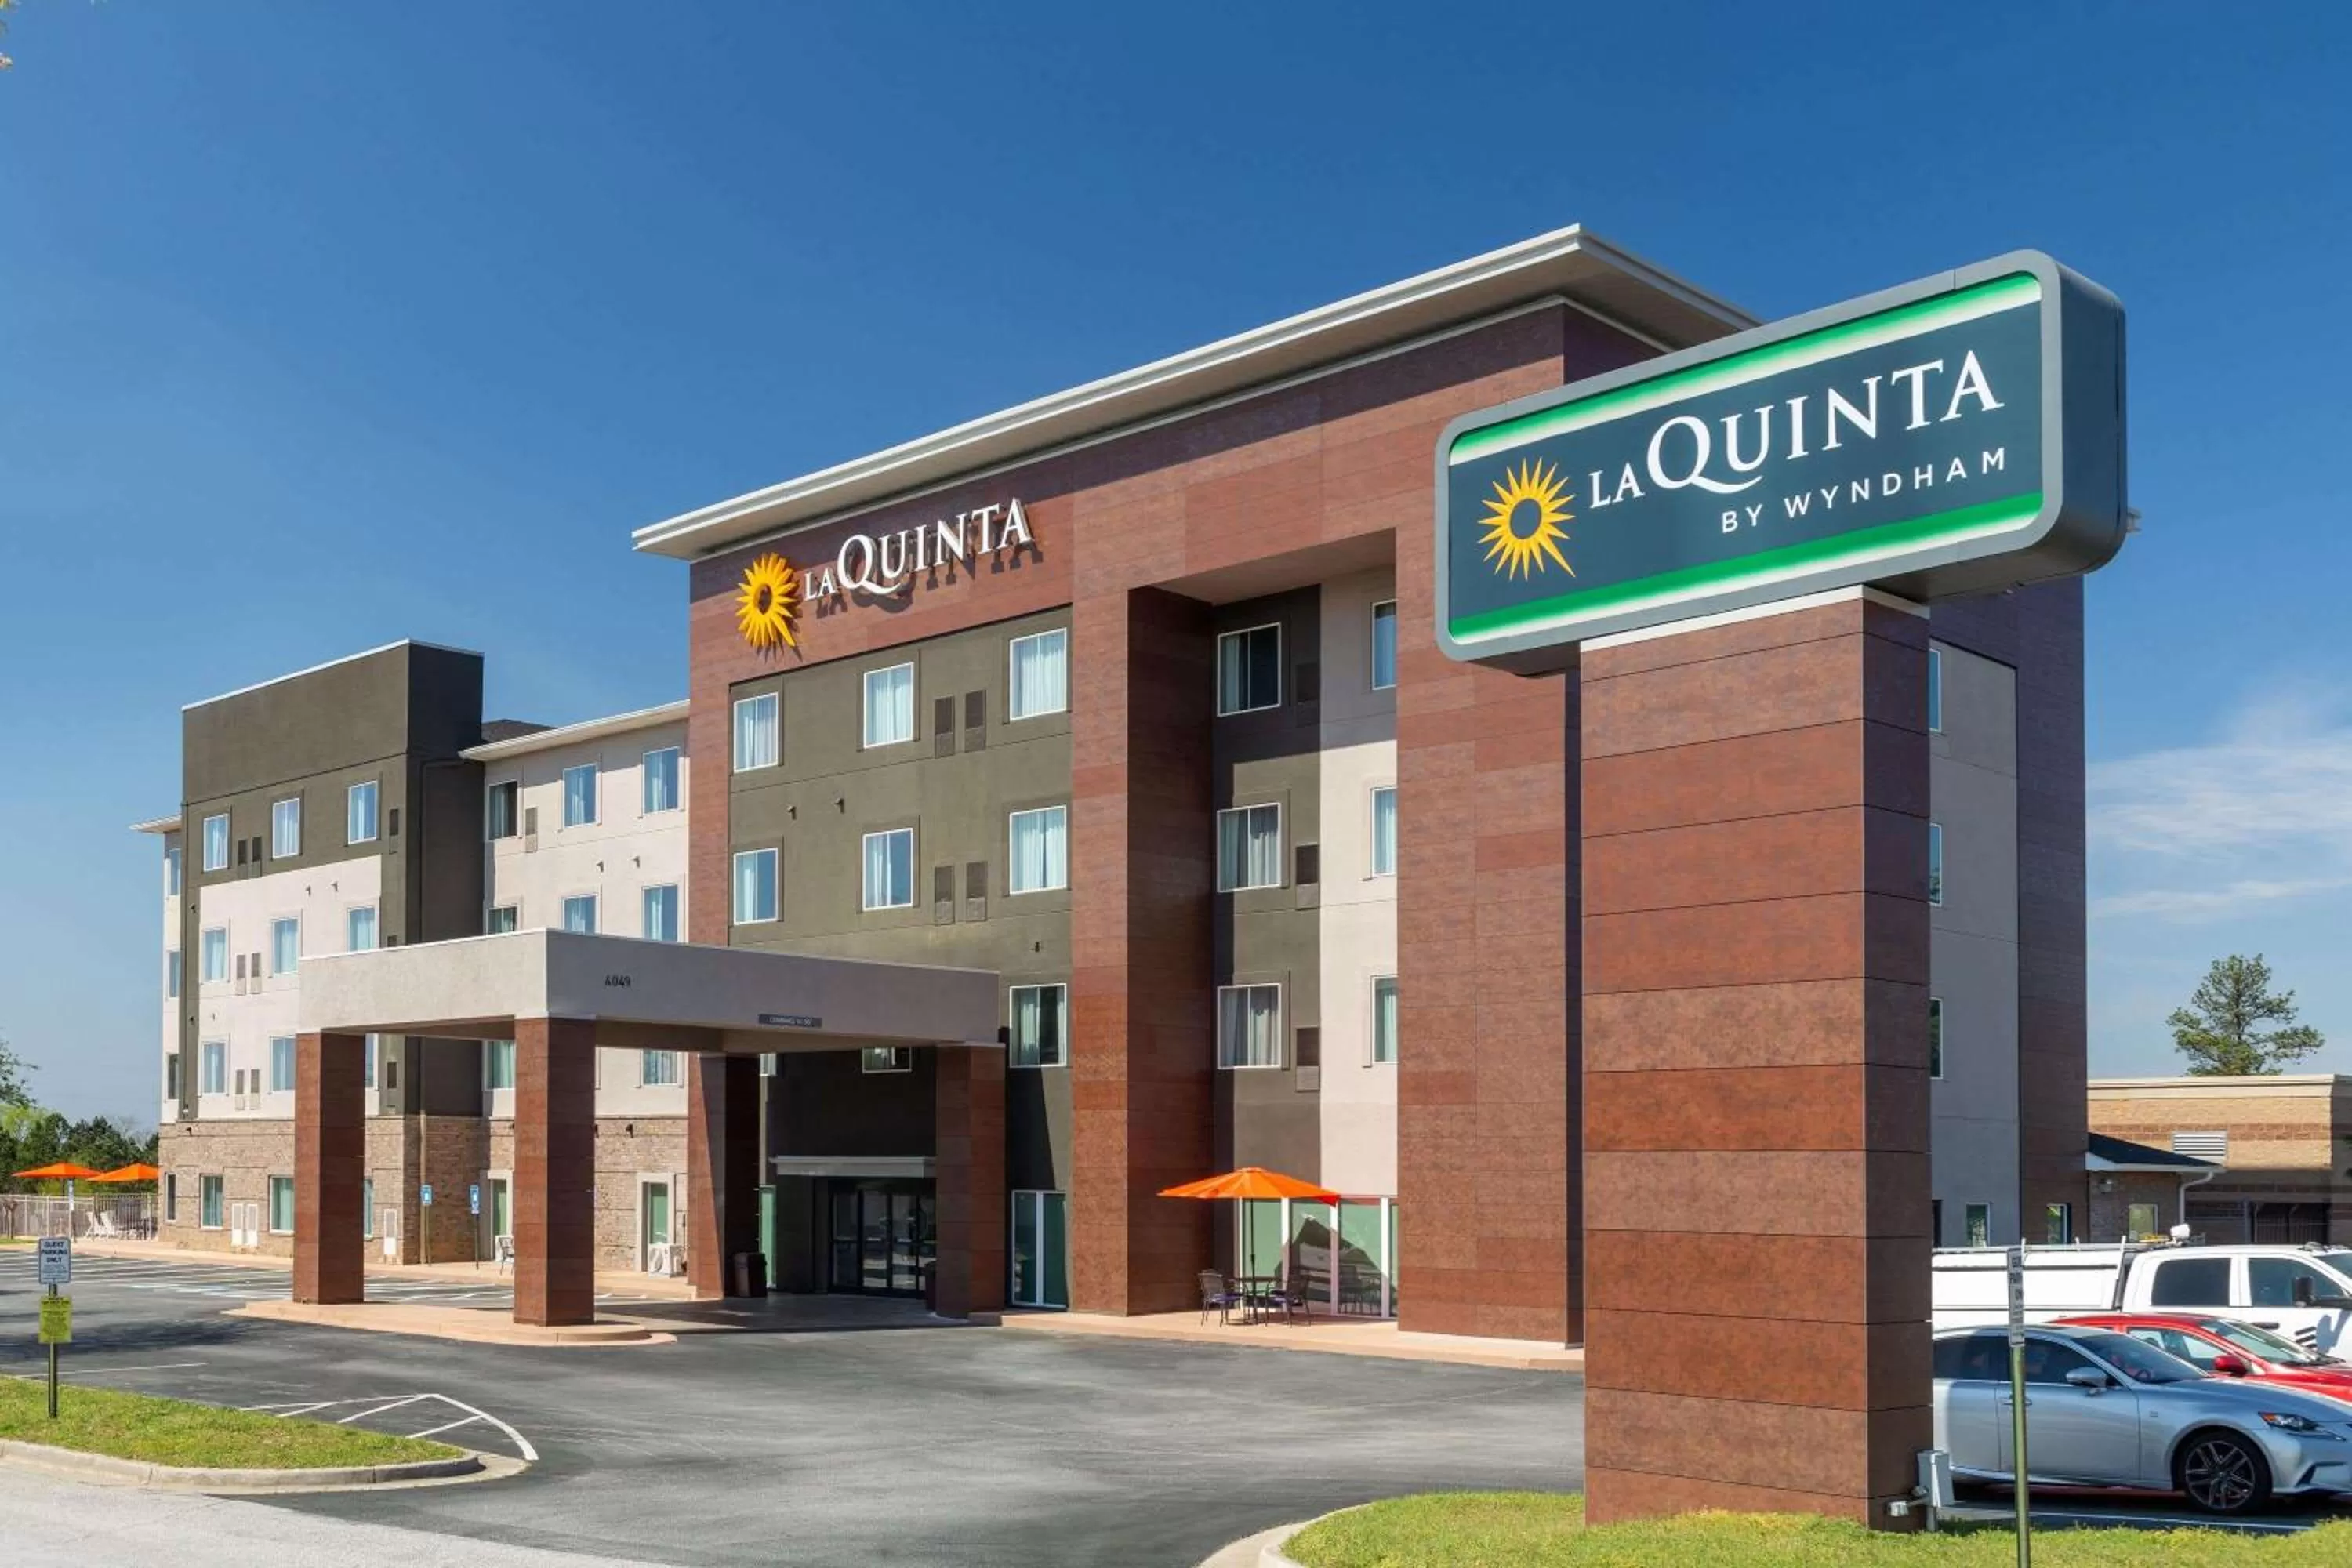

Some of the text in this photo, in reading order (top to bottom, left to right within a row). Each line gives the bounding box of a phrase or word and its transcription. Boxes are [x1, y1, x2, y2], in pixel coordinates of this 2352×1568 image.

[1588, 350, 2005, 510] LA QUINTA
[1721, 448, 2005, 533] BY WYNDHAM
[804, 497, 1033, 601] LA QUINTA
